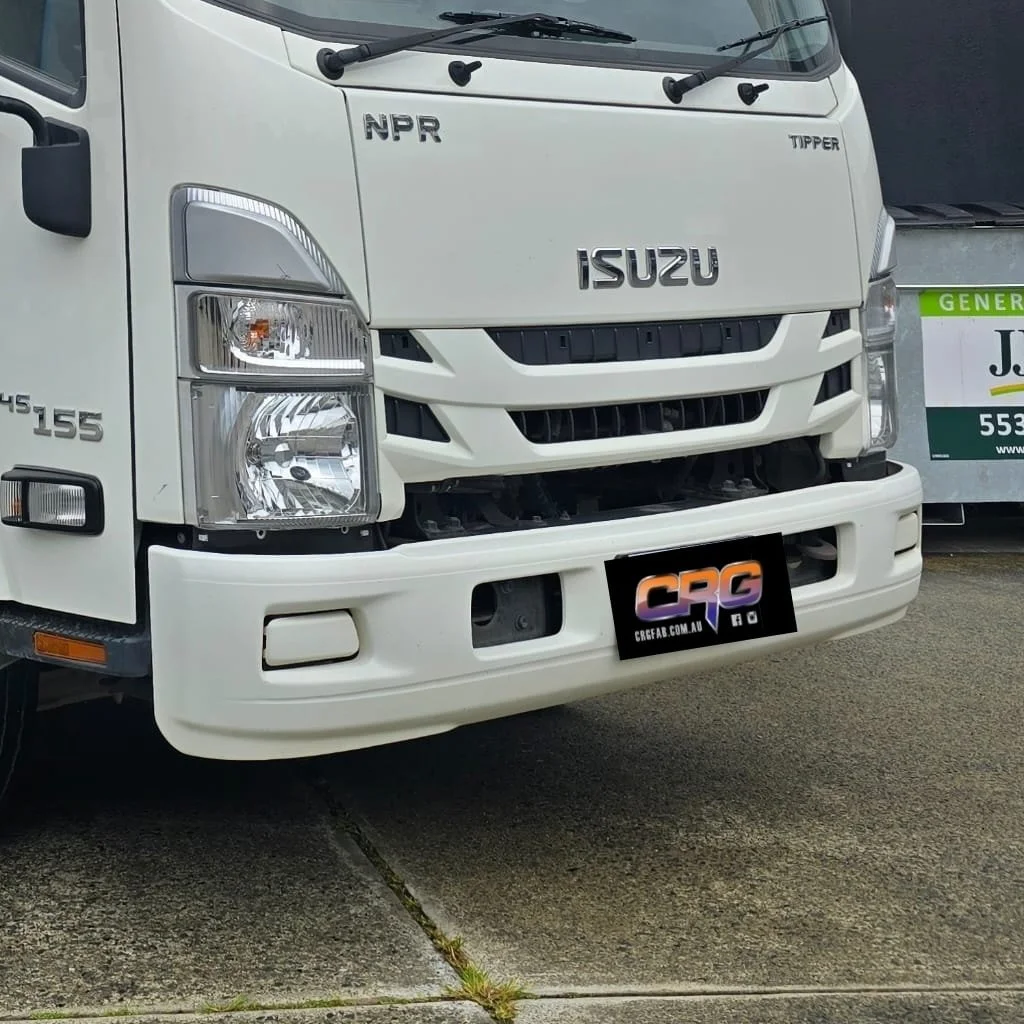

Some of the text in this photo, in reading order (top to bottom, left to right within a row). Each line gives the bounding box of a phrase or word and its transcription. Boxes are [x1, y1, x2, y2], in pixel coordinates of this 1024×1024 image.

[363, 113, 441, 143] NPR
[788, 134, 840, 151] TIPPER
[576, 246, 719, 290] ISUZU
[0, 392, 104, 442] 45 155
[979, 413, 1024, 436] 553
